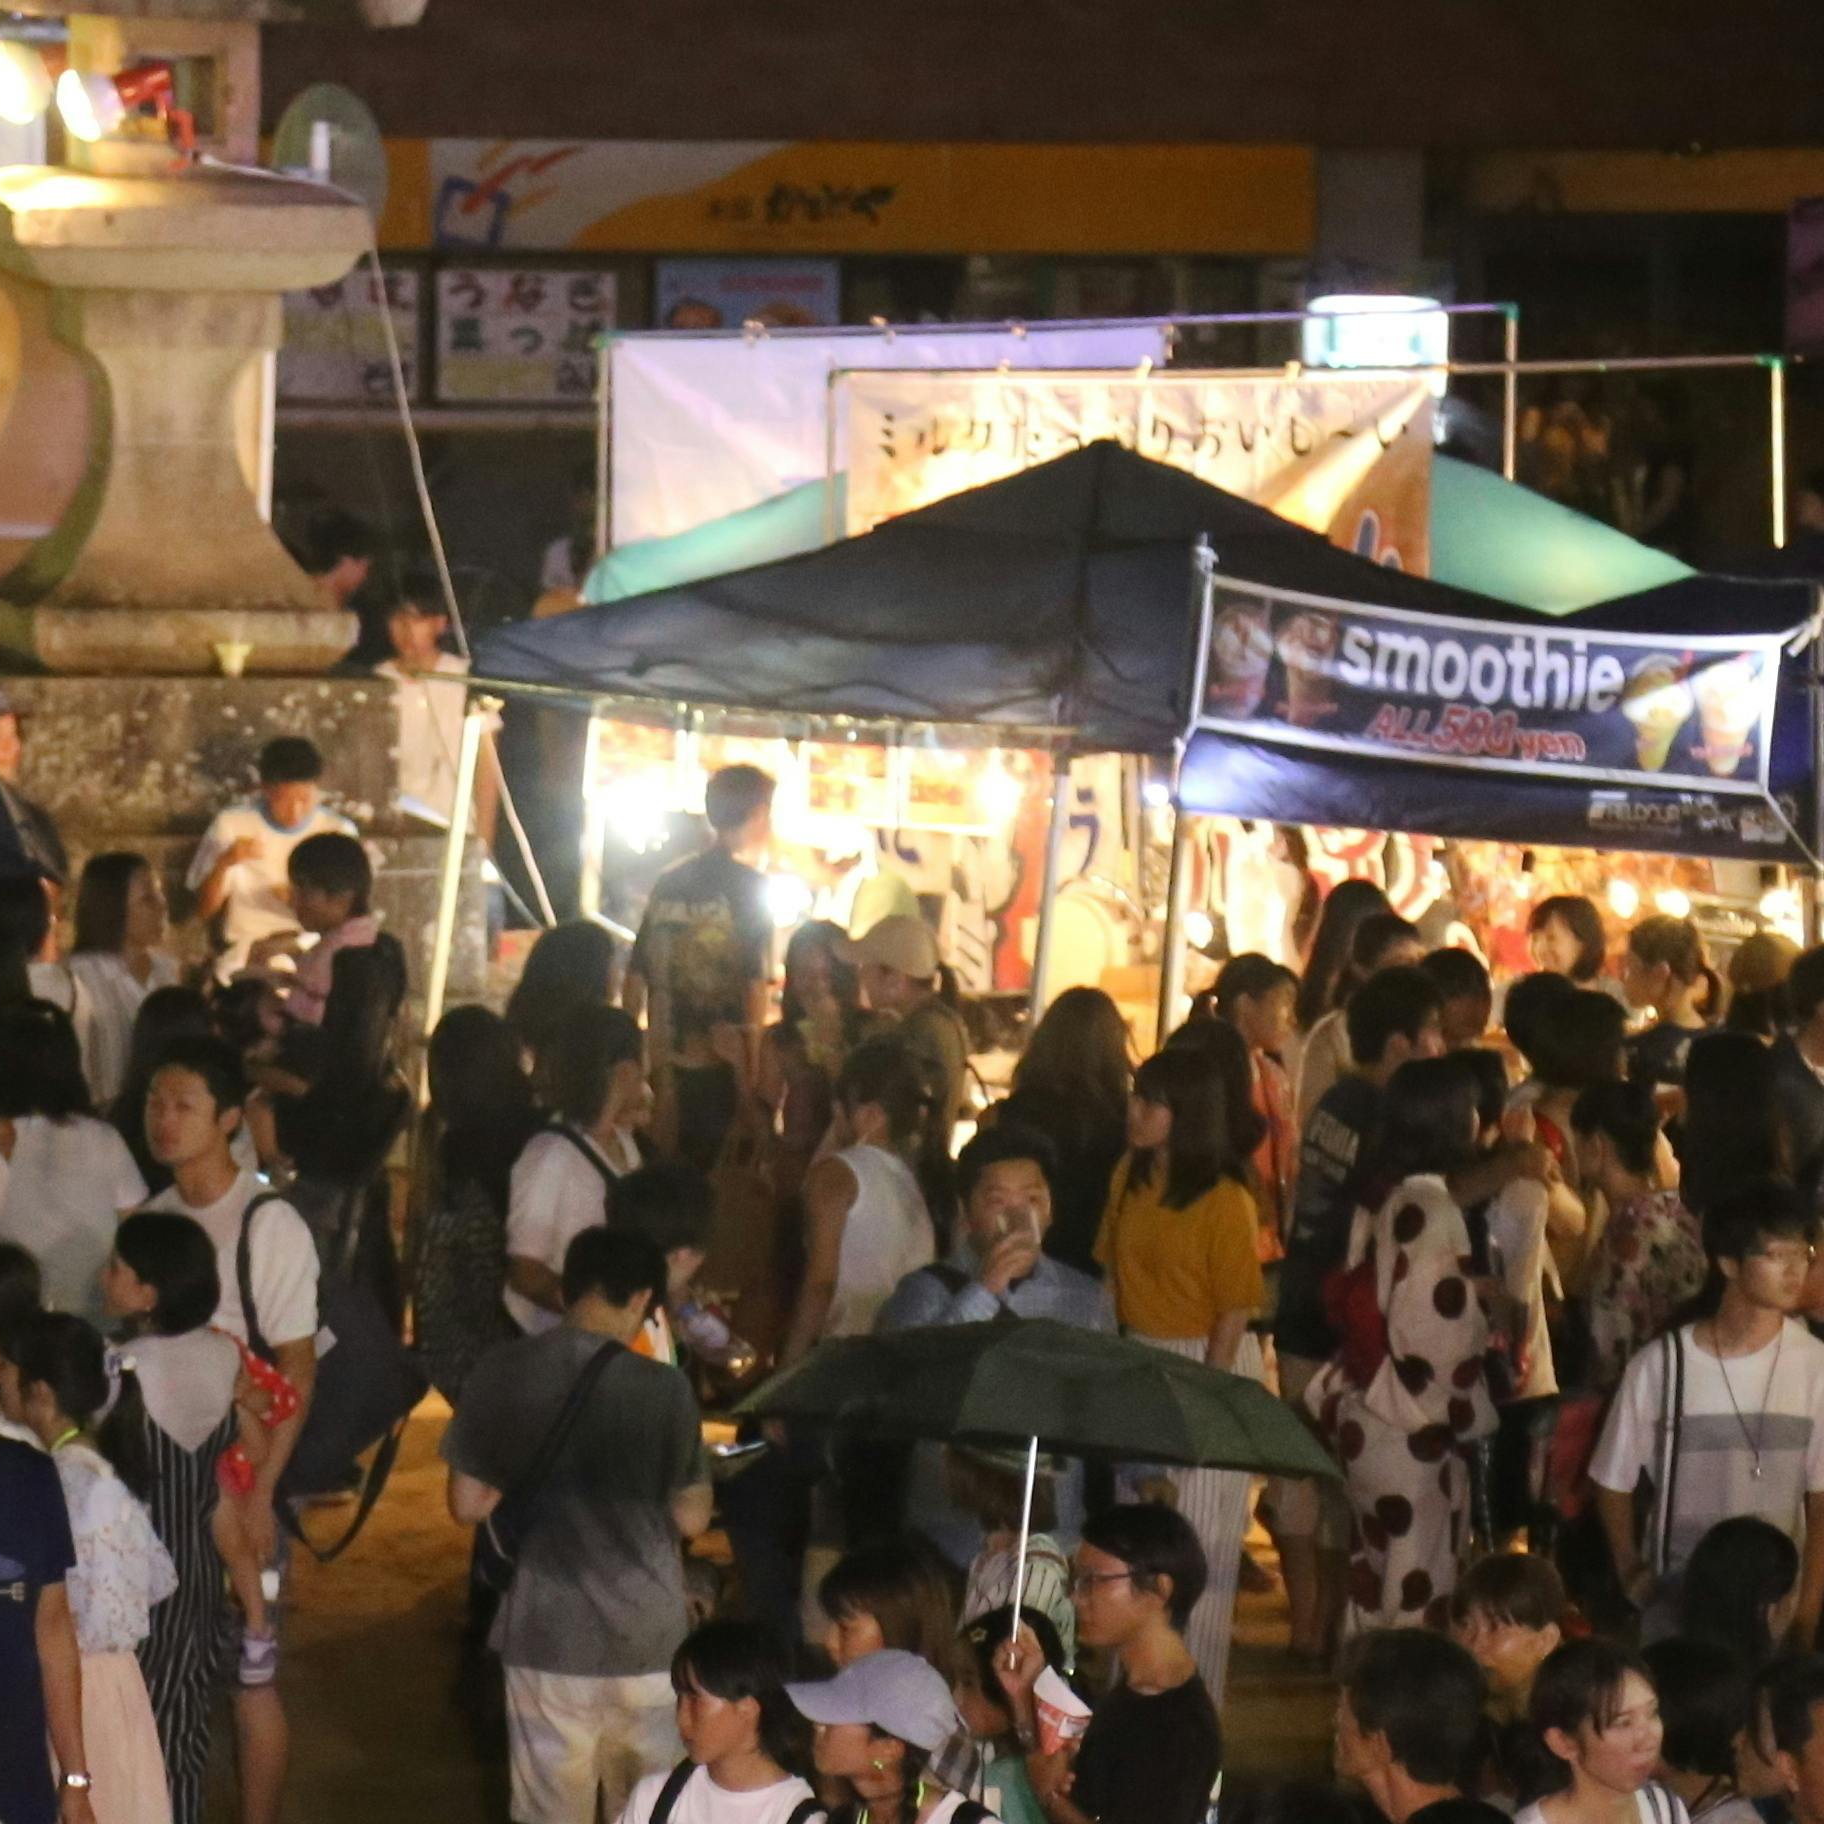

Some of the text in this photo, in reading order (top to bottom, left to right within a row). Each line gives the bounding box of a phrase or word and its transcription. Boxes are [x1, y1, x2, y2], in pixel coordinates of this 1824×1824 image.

[1339, 626, 1626, 713] smoothie
[1367, 704, 1432, 750] ALL
[1514, 727, 1587, 762] yen
